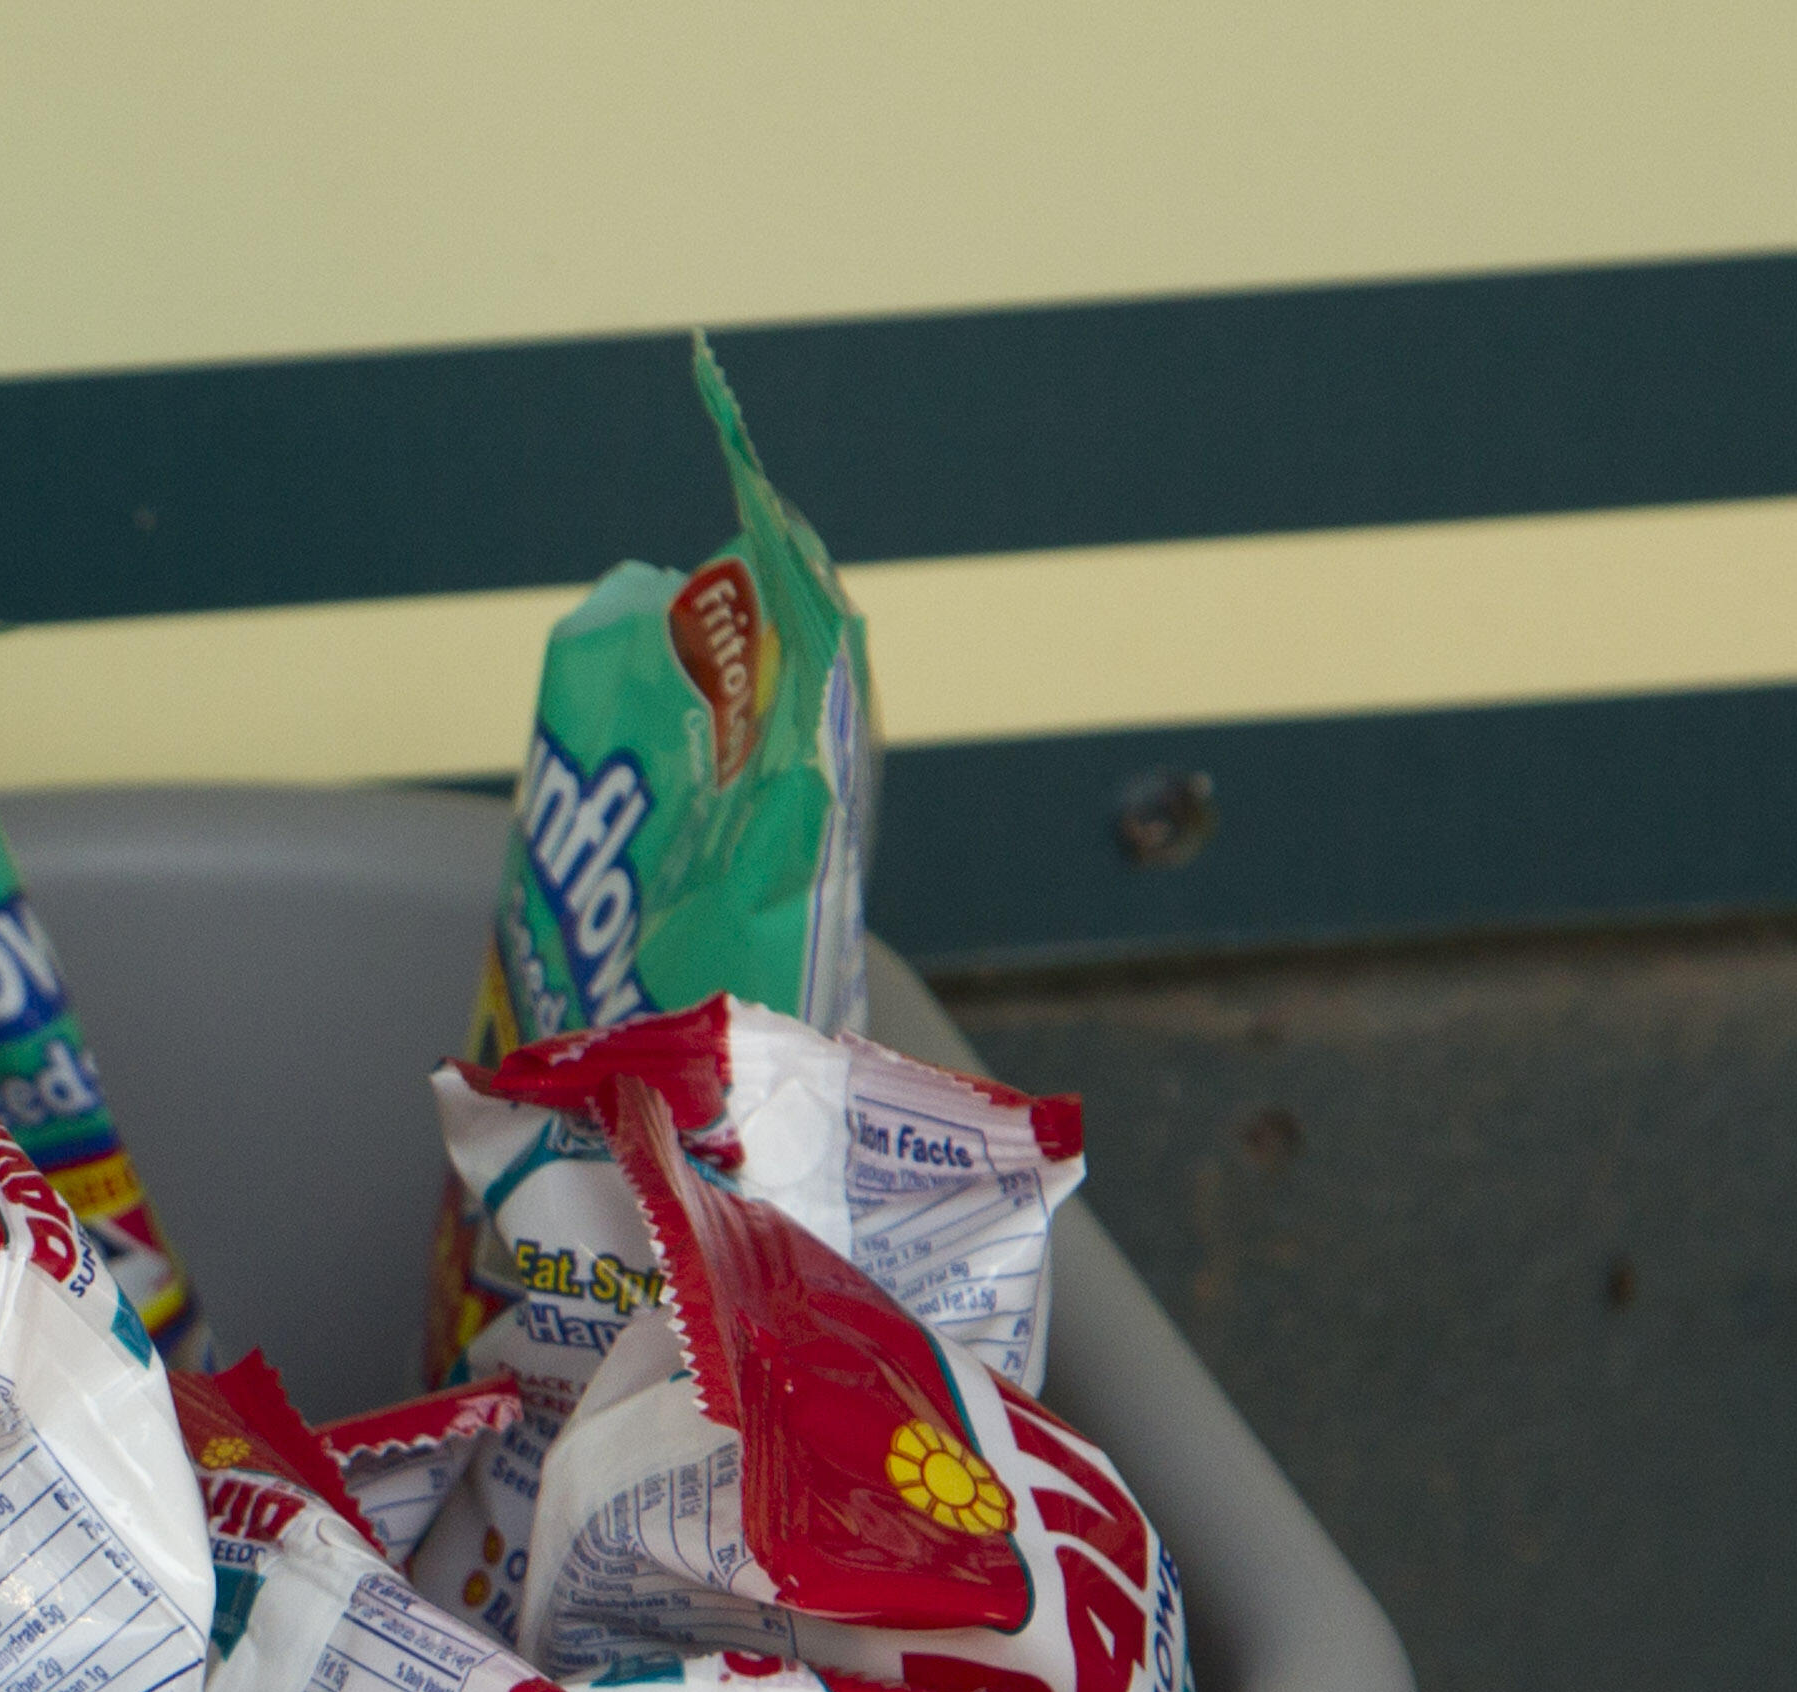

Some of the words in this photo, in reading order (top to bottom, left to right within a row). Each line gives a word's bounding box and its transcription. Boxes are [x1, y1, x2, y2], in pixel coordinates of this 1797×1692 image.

[897, 1123, 974, 1169] Facts
[39, 1603, 68, 1625] 5g
[37, 1655, 65, 1679] 2g
